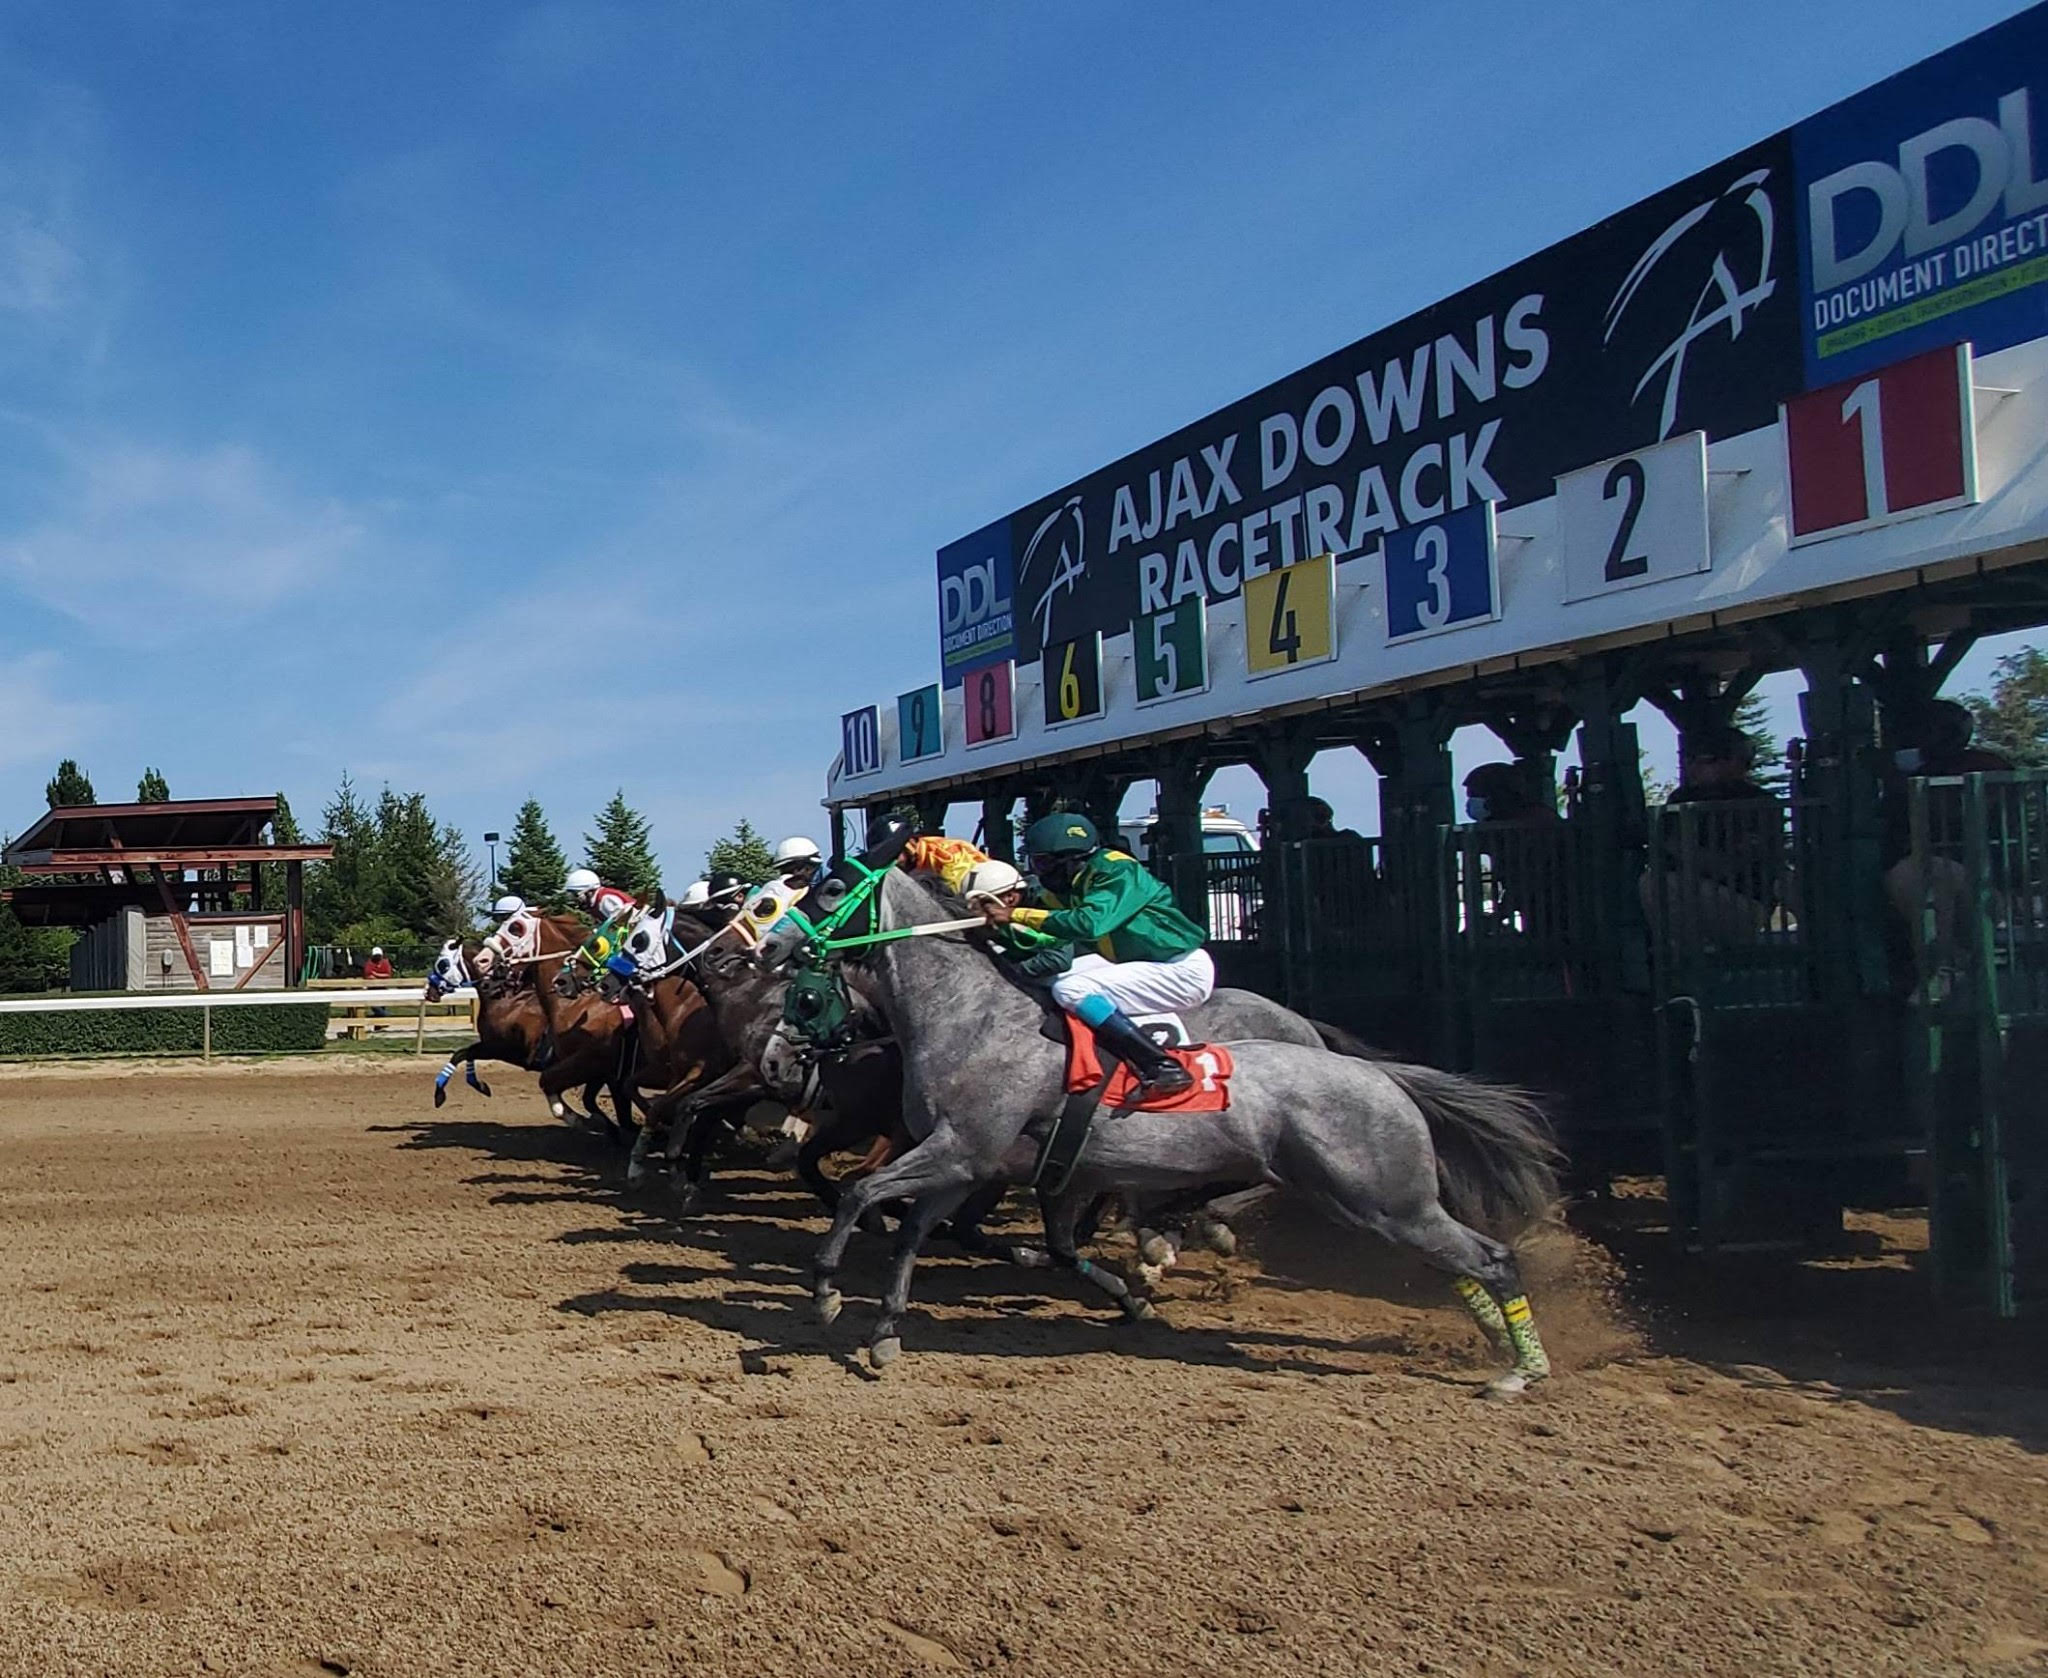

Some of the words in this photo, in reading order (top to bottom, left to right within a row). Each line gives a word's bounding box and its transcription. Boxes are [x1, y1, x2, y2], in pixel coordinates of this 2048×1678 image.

[1808, 86, 2048, 294] DDL
[1815, 253, 1947, 330] DOCUMENT
[1108, 434, 1242, 554] AJAX
[1260, 293, 1549, 491] DOWNS
[1841, 378, 1888, 520] 1
[1139, 418, 1507, 614] RACETRACK
[1603, 459, 1649, 583] 2
[941, 557, 1011, 636] DDL
[1269, 571, 1301, 663] 4
[1413, 525, 1451, 630] 3
[1060, 642, 1080, 719] 6
[1153, 611, 1178, 696] 5
[846, 711, 872, 775] 10
[912, 694, 925, 757] 9
[980, 672, 996, 739] 8
[1195, 1051, 1220, 1092] 1
